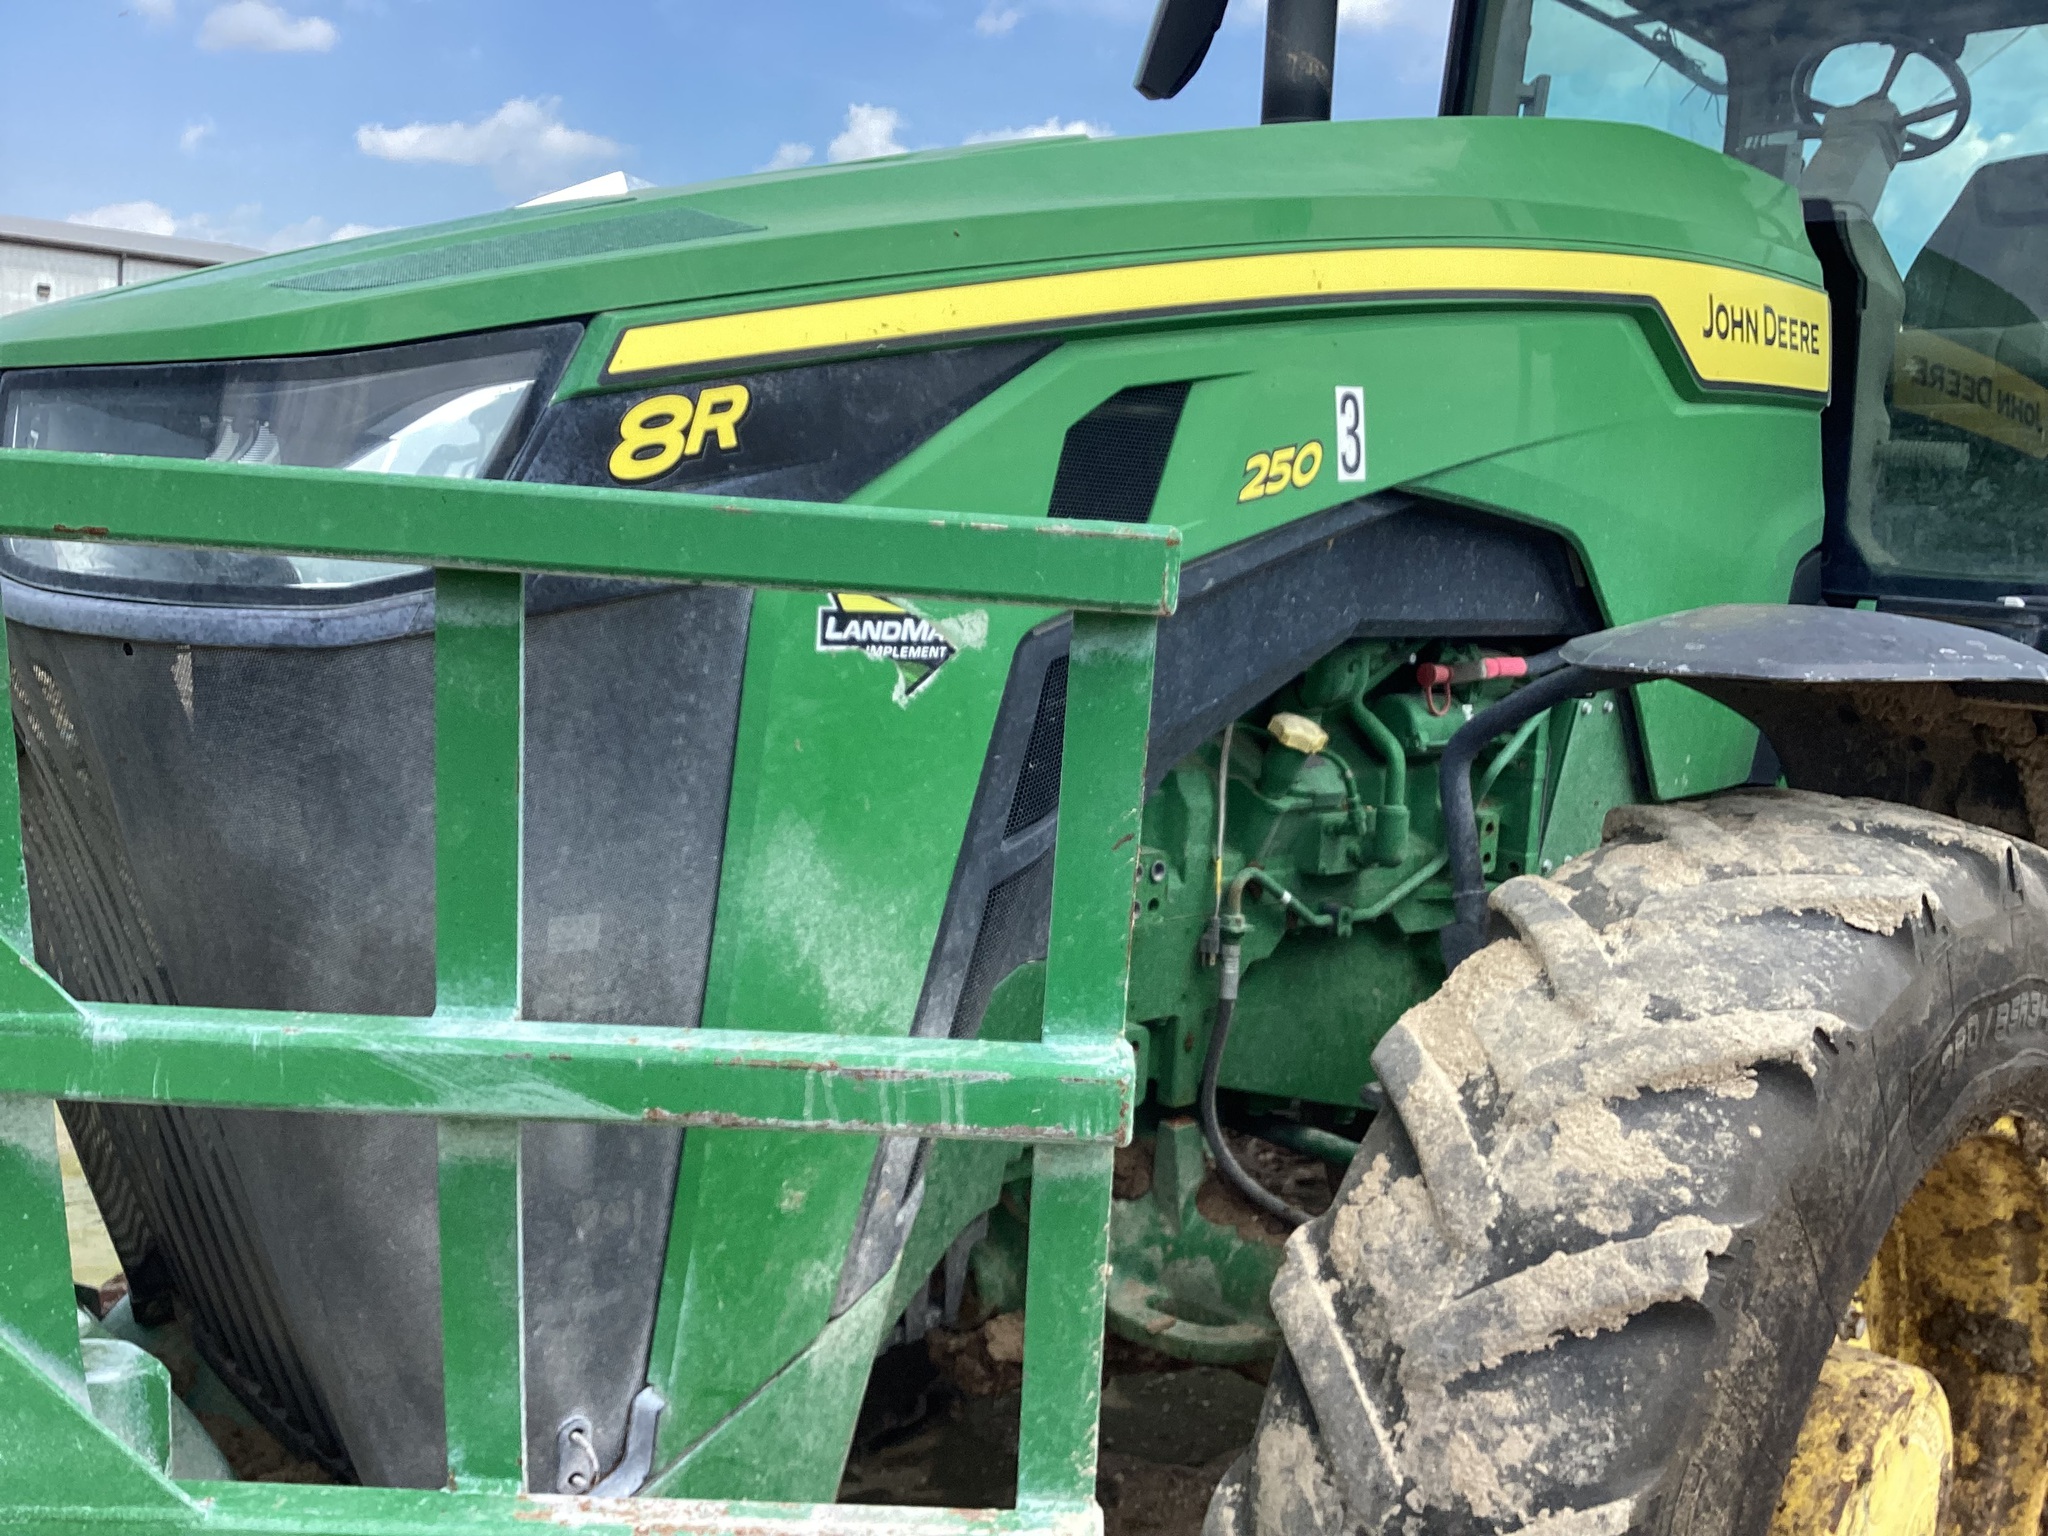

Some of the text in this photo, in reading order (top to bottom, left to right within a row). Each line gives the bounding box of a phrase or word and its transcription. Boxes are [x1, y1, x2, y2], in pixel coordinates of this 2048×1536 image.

[1703, 293, 1820, 354] JOHN DEERE
[608, 384, 749, 481] 8R
[1341, 392, 1361, 474] 3
[1237, 439, 1323, 503] 250
[866, 645, 947, 660] IMPLEMENT
